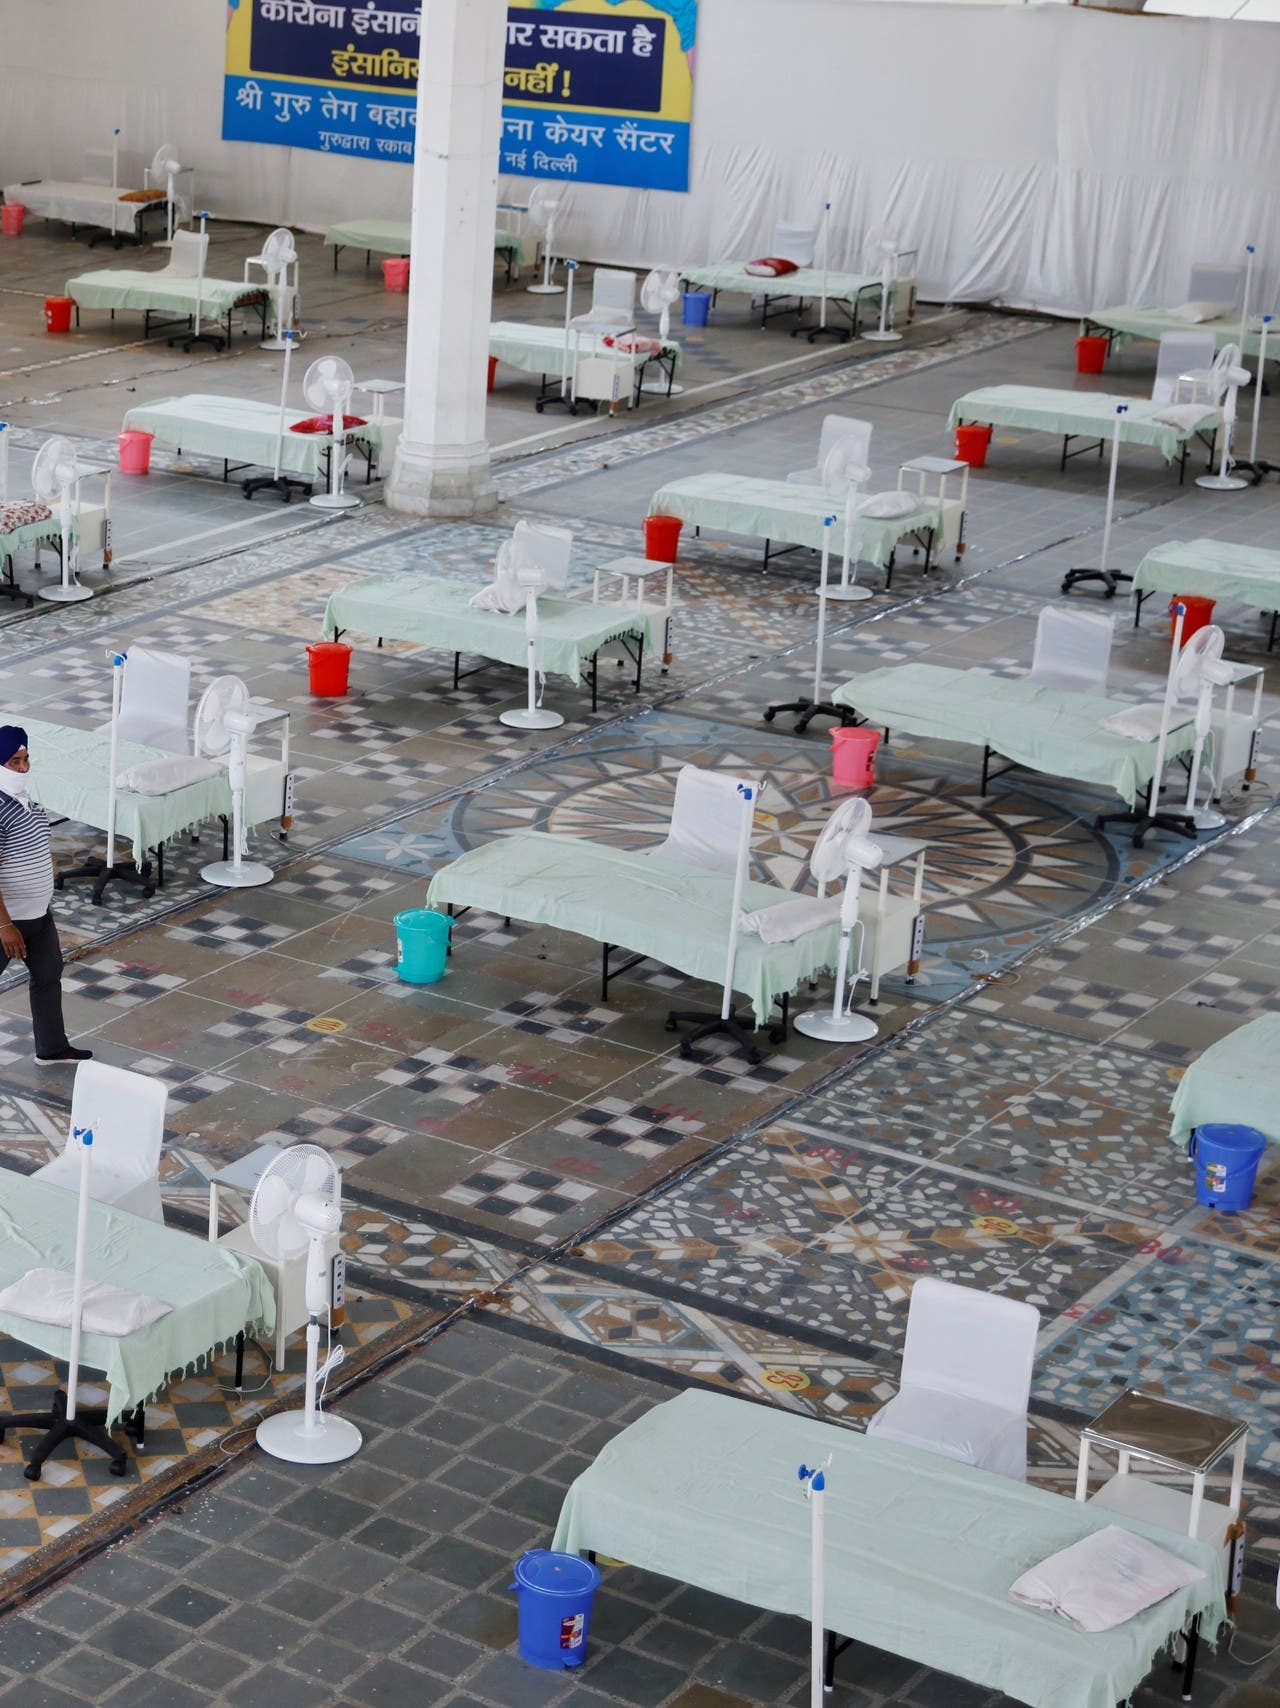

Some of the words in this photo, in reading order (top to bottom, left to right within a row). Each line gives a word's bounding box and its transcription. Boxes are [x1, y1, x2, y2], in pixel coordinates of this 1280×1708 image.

[504, 21, 536, 47] ार
[539, 24, 627, 54] सकता
[631, 23, 657, 57] है
[504, 62, 559, 95] नहीं
[235, 80, 263, 111] श्री
[271, 91, 312, 122] गुरु
[320, 91, 358, 122] तेग
[543, 114, 606, 149] केयर
[613, 121, 675, 155] सैंटर
[318, 130, 370, 152] गुरुद्वारा
[375, 137, 413, 155] रकाब
[503, 148, 528, 170] नई
[532, 150, 578, 174] दिल्ली
